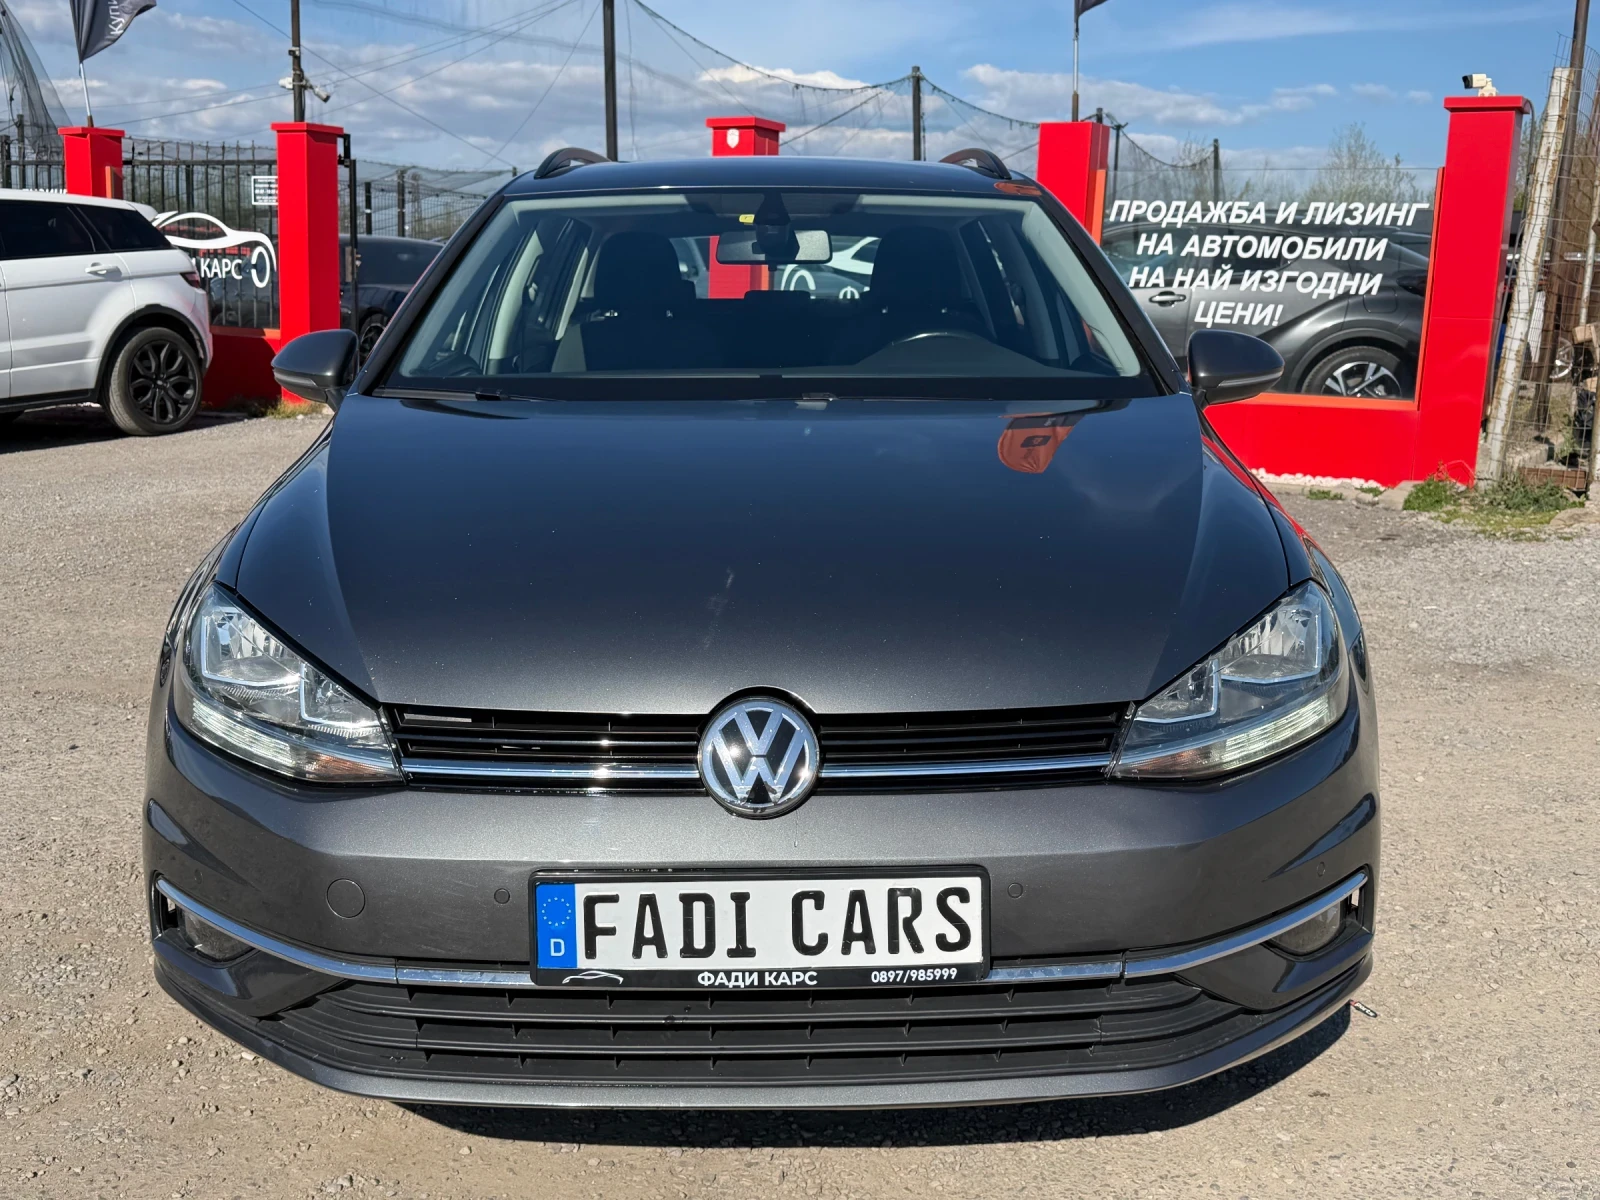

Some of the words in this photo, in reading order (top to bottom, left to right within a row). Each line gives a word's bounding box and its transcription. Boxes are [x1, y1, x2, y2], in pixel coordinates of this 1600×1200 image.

[1108, 199, 1266, 228] ПРОДАЖБА
[1274, 202, 1297, 225] И
[1301, 201, 1430, 226] ЛИЗИНГ
[1136, 233, 1174, 256] НА
[1180, 235, 1388, 261] АВТОМОБИЛИ
[200, 257, 243, 280] КАРС
[1128, 266, 1165, 288] НА
[1171, 263, 1233, 292] НАЙ
[1239, 269, 1383, 300] ИЗГОДНИ
[1194, 301, 1285, 328] ЦЕНИ!
[583, 890, 757, 960] FADI
[791, 886, 971, 956] CARS
[550, 937, 565, 957] D
[697, 970, 758, 989] ФАДИ
[764, 970, 818, 987] КАРС
[871, 967, 959, 984] 0897/985999
